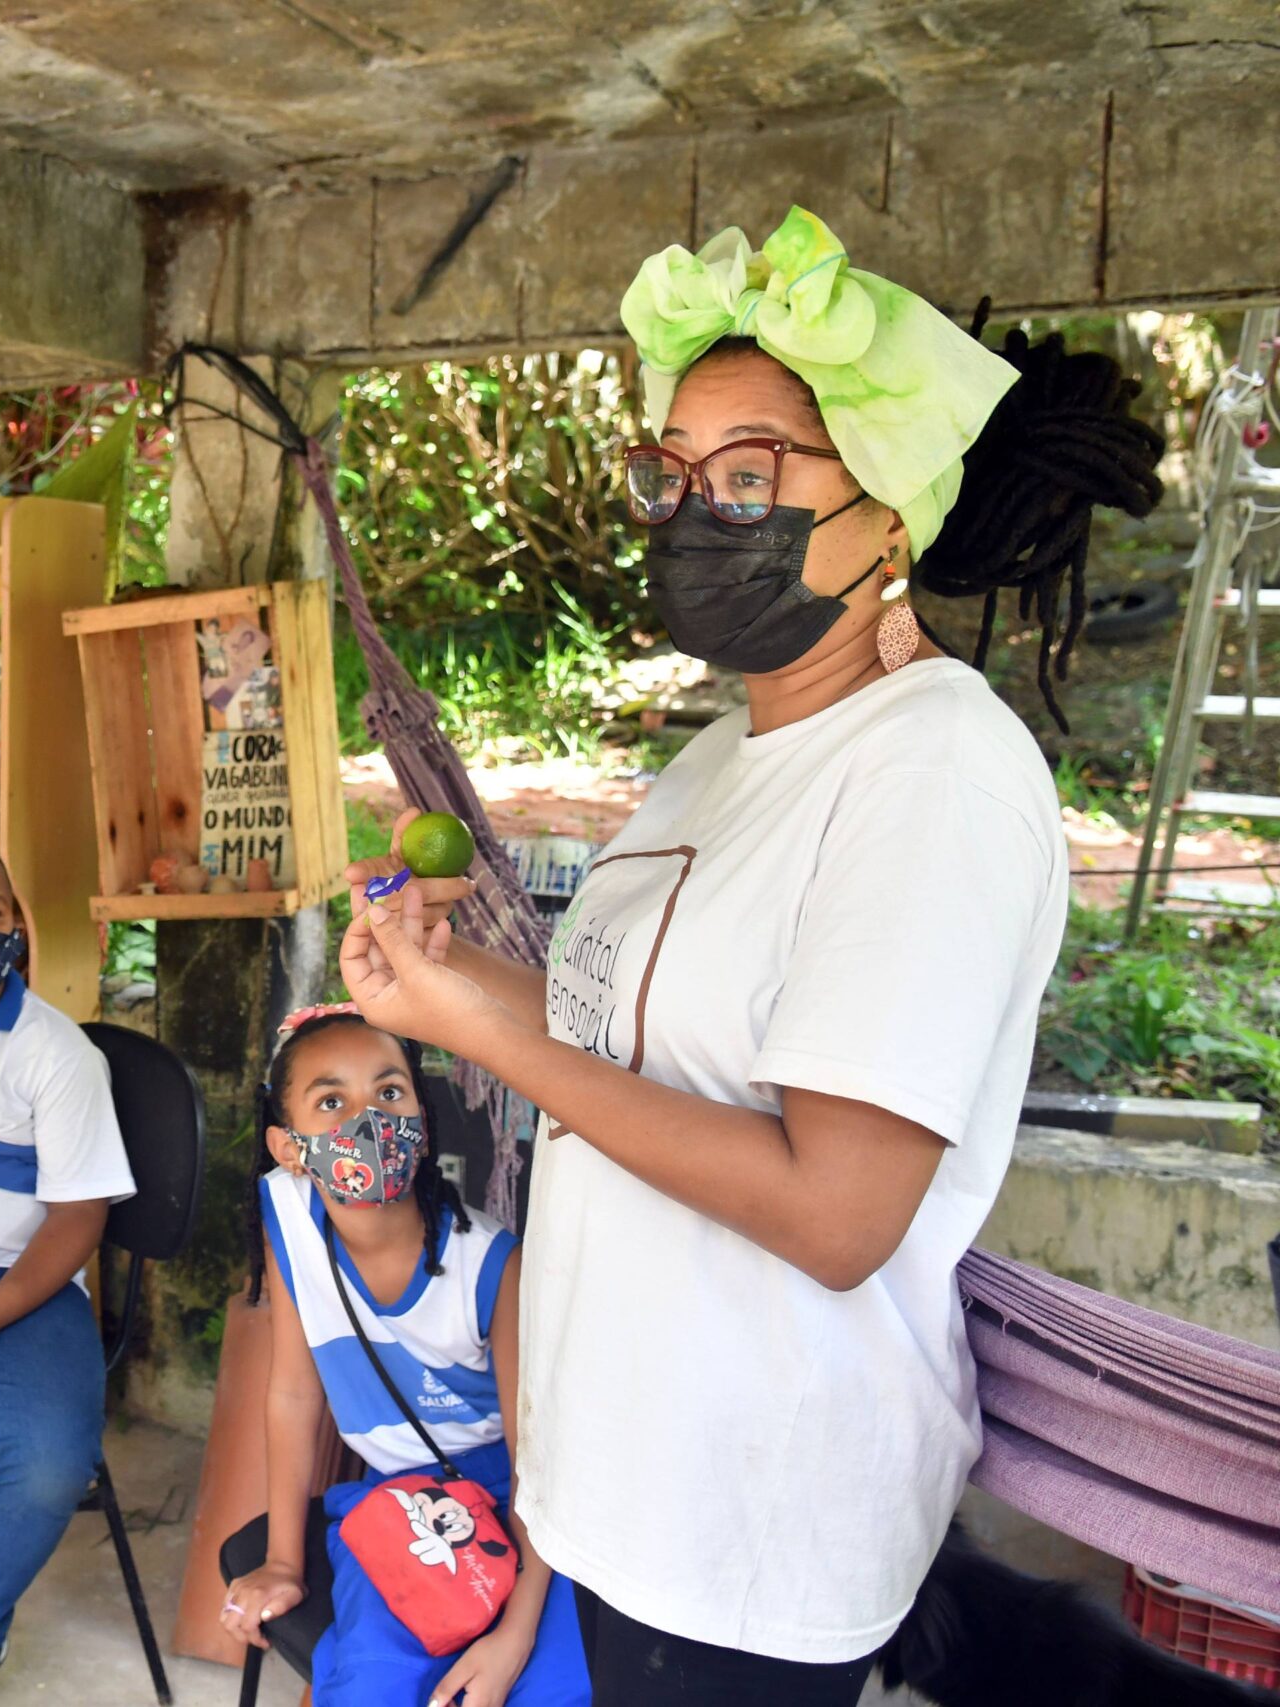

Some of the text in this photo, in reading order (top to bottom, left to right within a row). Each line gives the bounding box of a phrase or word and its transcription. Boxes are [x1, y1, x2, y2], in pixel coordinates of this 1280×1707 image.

[204, 765, 288, 790] VAGABUN
[204, 805, 291, 830] O MUND
[222, 835, 283, 876] MIM
